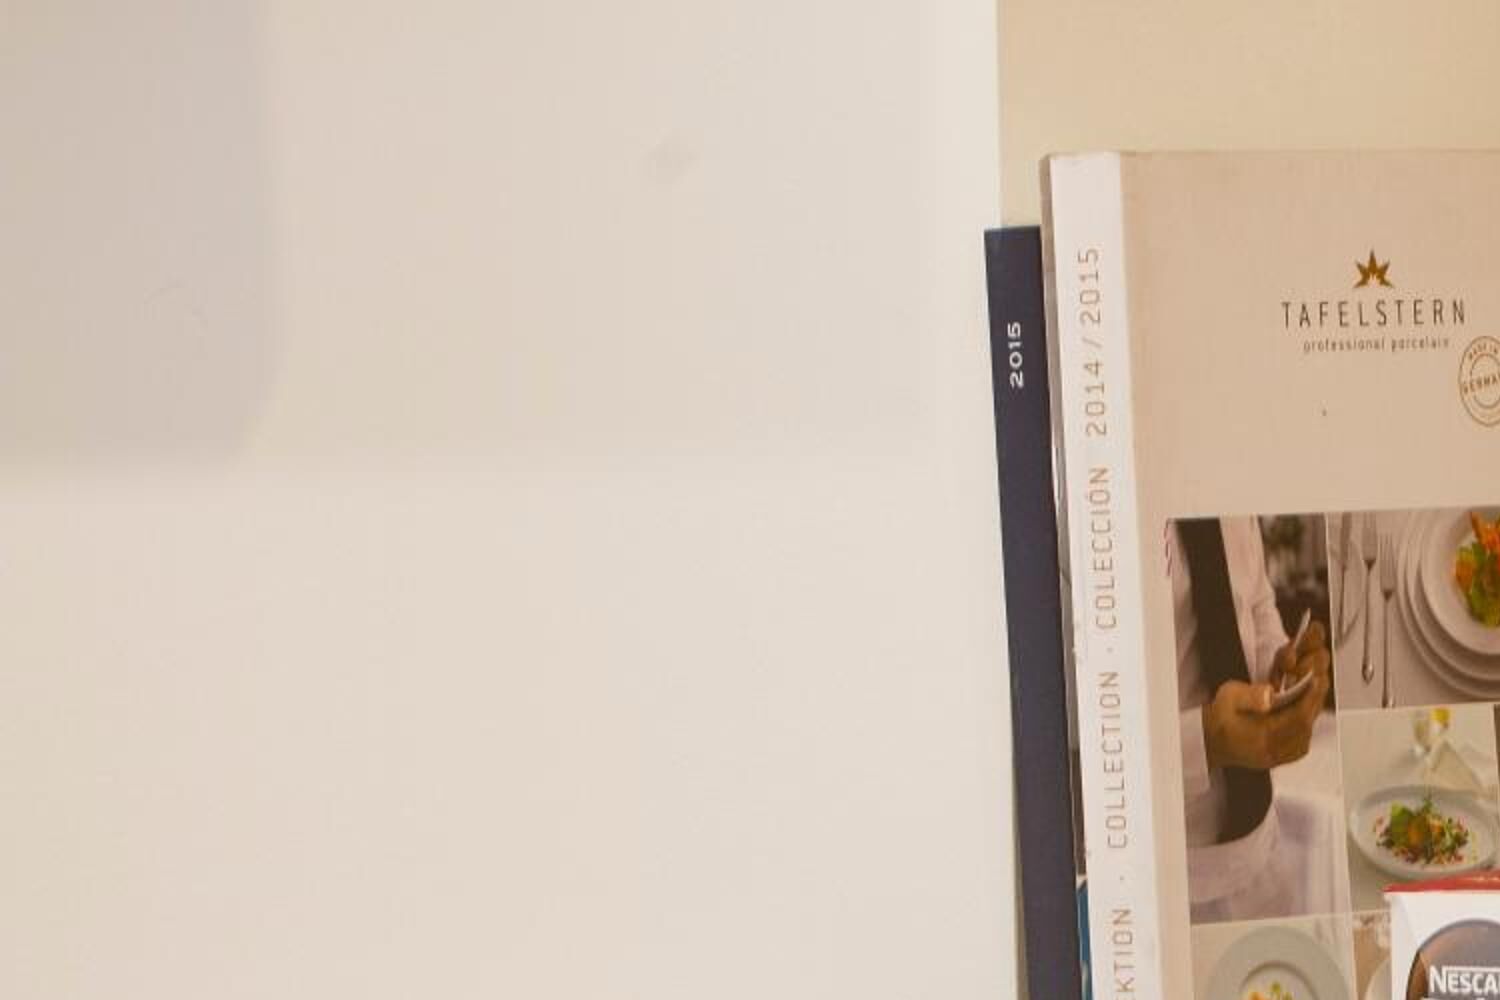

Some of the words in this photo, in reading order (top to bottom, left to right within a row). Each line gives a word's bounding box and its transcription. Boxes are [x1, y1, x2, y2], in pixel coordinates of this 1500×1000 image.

[1078, 247, 1100, 325] 2015
[1281, 299, 1466, 329] TAFELSTERN
[1007, 321, 1022, 388] 2015
[1303, 338, 1386, 354] professional
[1391, 335, 1450, 352] porcelain
[1085, 362, 1107, 437] 2014
[1100, 671, 1128, 850] COLLECTION
